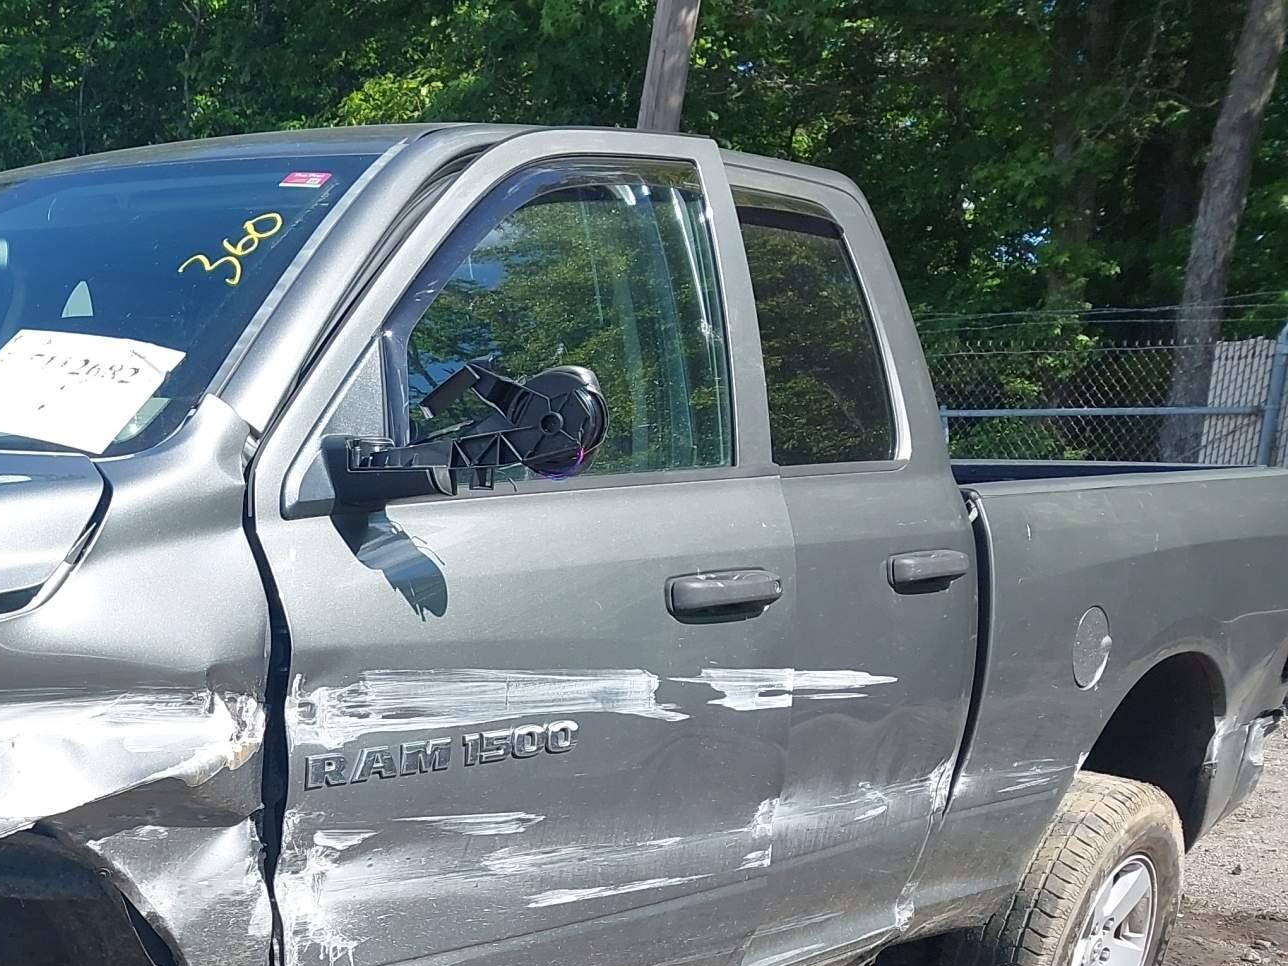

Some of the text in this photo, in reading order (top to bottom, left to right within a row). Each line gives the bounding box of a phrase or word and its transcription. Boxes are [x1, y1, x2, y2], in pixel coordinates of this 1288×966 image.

[177, 212, 283, 285] 360
[304, 719, 579, 791] RAM 1500
